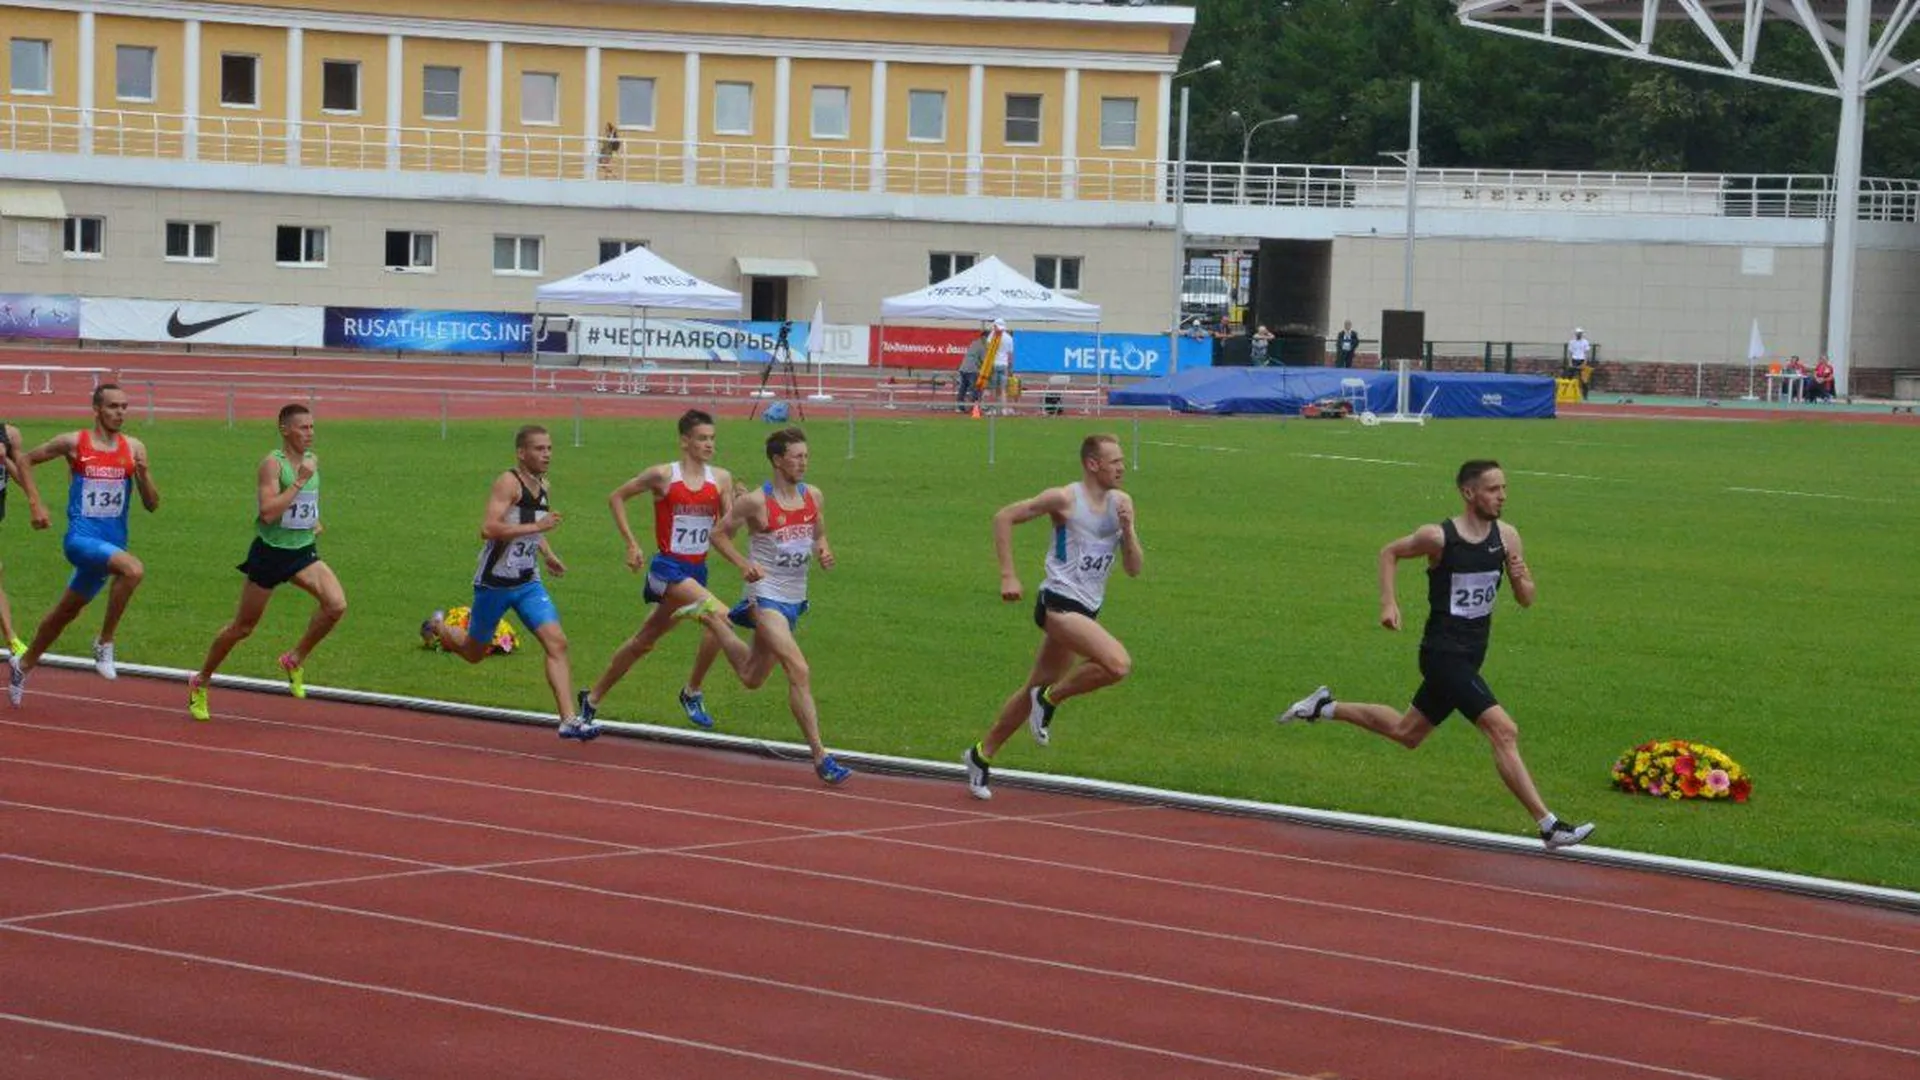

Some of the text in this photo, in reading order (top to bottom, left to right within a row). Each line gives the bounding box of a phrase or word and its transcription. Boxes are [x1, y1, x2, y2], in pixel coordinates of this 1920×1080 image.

[1063, 345, 1159, 371] МЕТЕОР
[86, 491, 123, 507] 134
[289, 503, 316, 519] 131
[675, 527, 709, 544] 710
[1080, 554, 1113, 572] 347
[1455, 585, 1495, 607] 250
